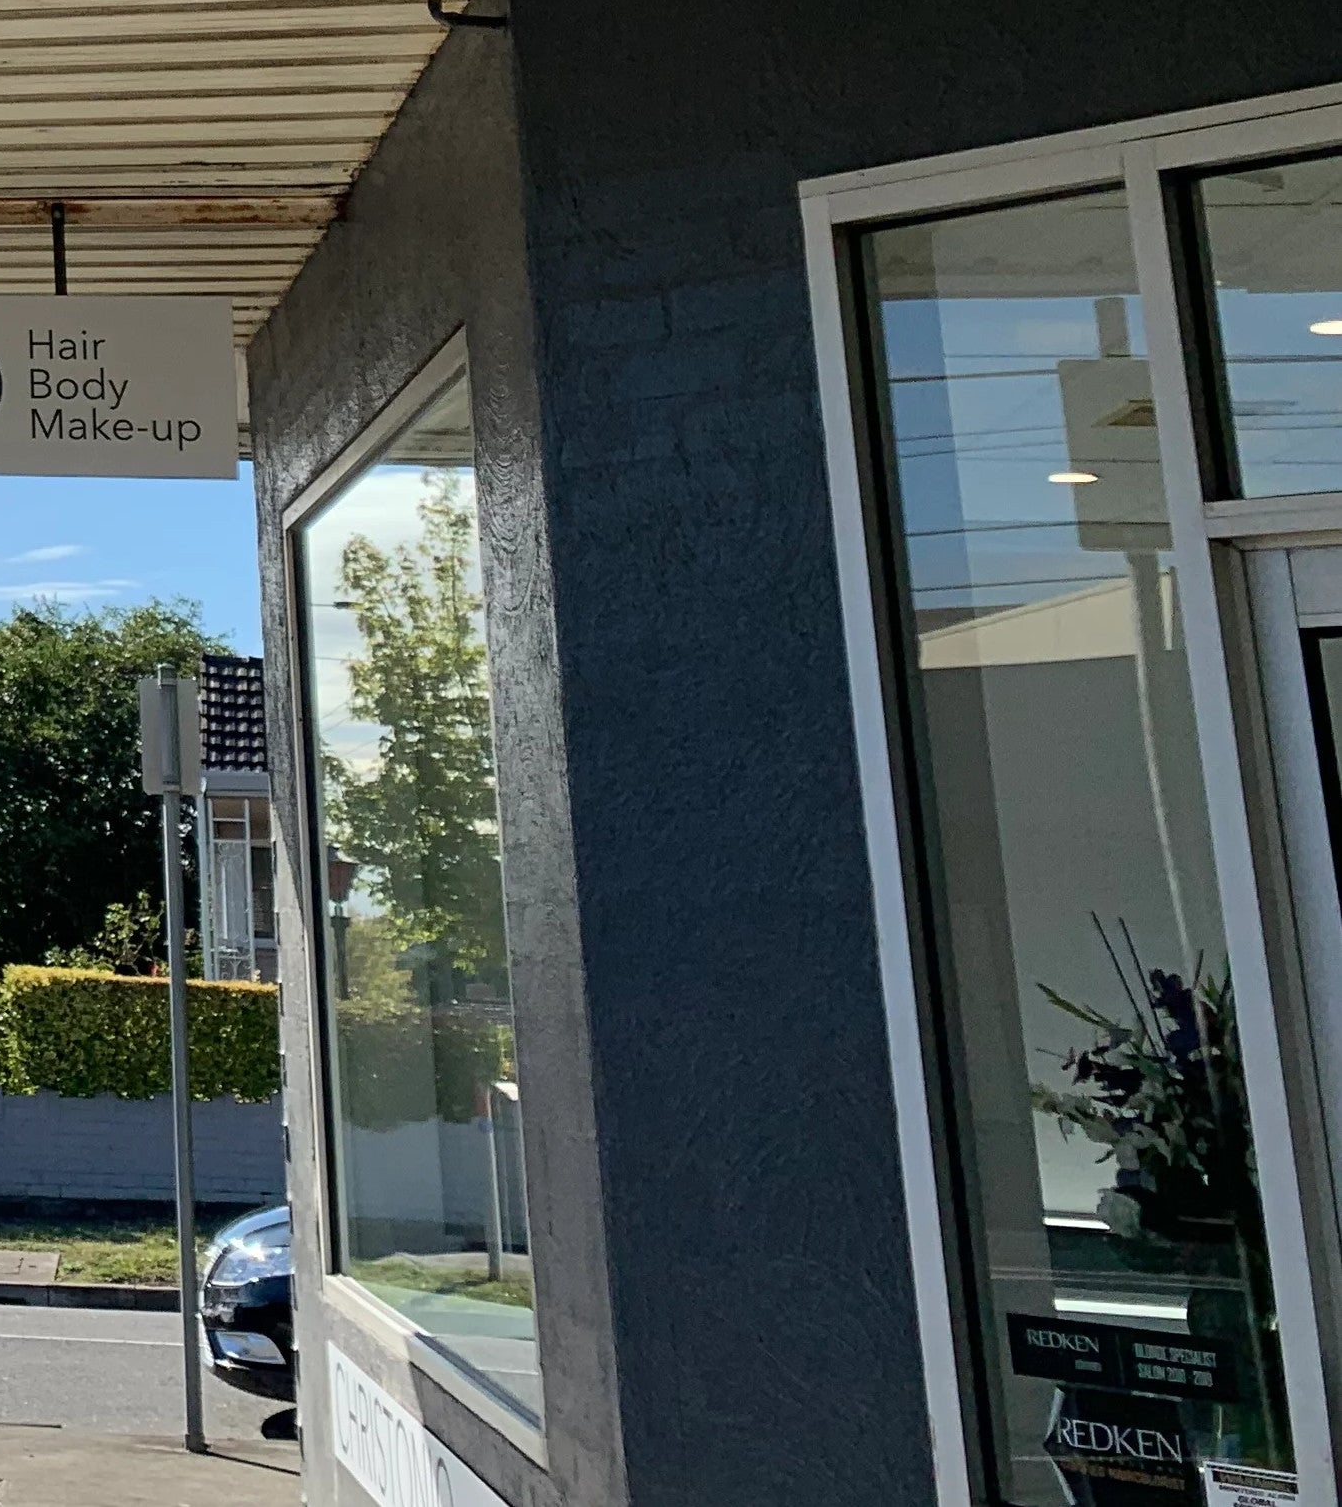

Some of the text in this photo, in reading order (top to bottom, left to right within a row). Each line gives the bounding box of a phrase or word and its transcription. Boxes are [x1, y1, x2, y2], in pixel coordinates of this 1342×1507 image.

[28, 329, 106, 361] Hair
[29, 367, 129, 411] Body
[30, 408, 203, 452] Make-up
[1026, 1328, 1100, 1353] REDKEN
[1056, 1418, 1183, 1464] REDKEN
